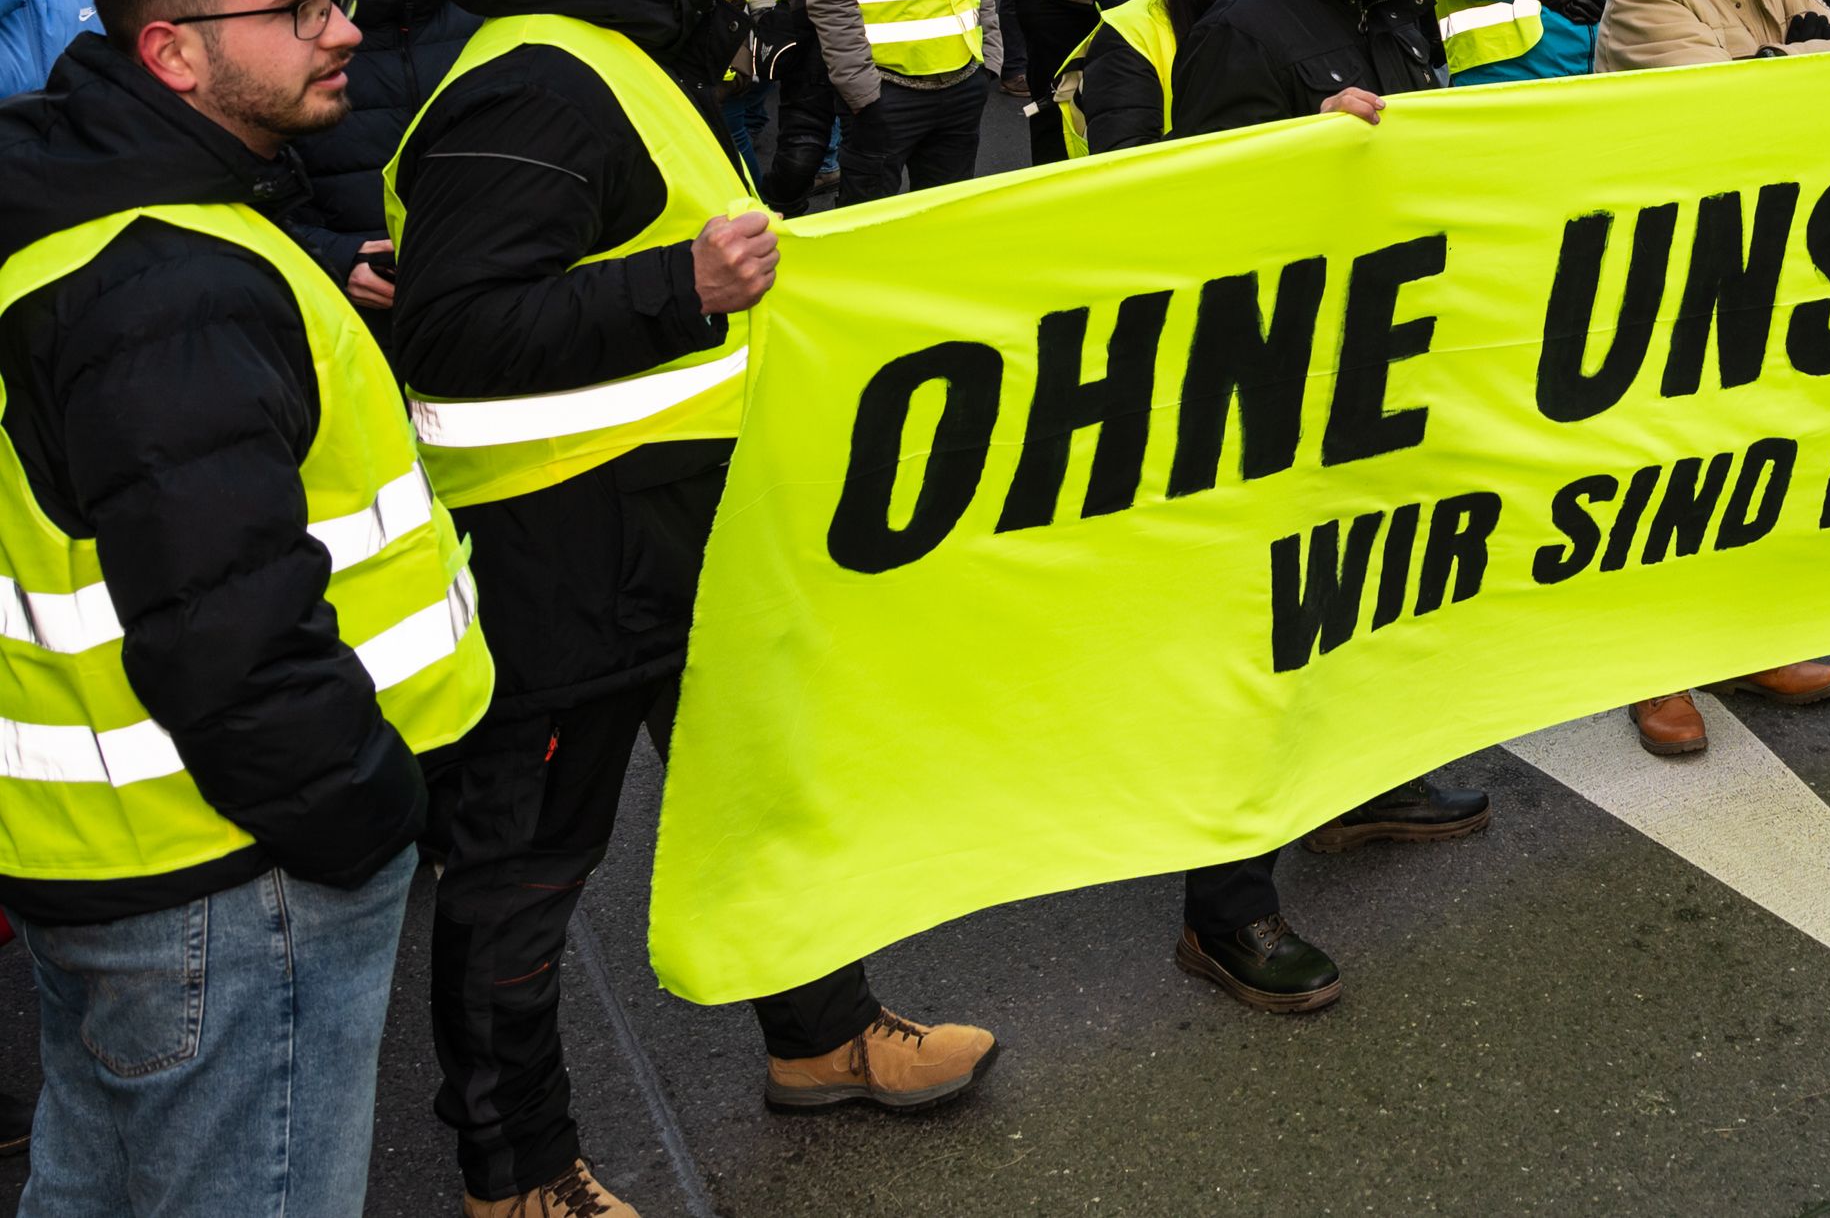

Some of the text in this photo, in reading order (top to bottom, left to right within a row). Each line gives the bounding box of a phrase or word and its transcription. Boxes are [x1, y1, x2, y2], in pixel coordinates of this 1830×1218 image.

[827, 233, 1447, 574] OHNE
[1271, 492, 1502, 673] WIR
[1532, 438, 1797, 584] SIND
